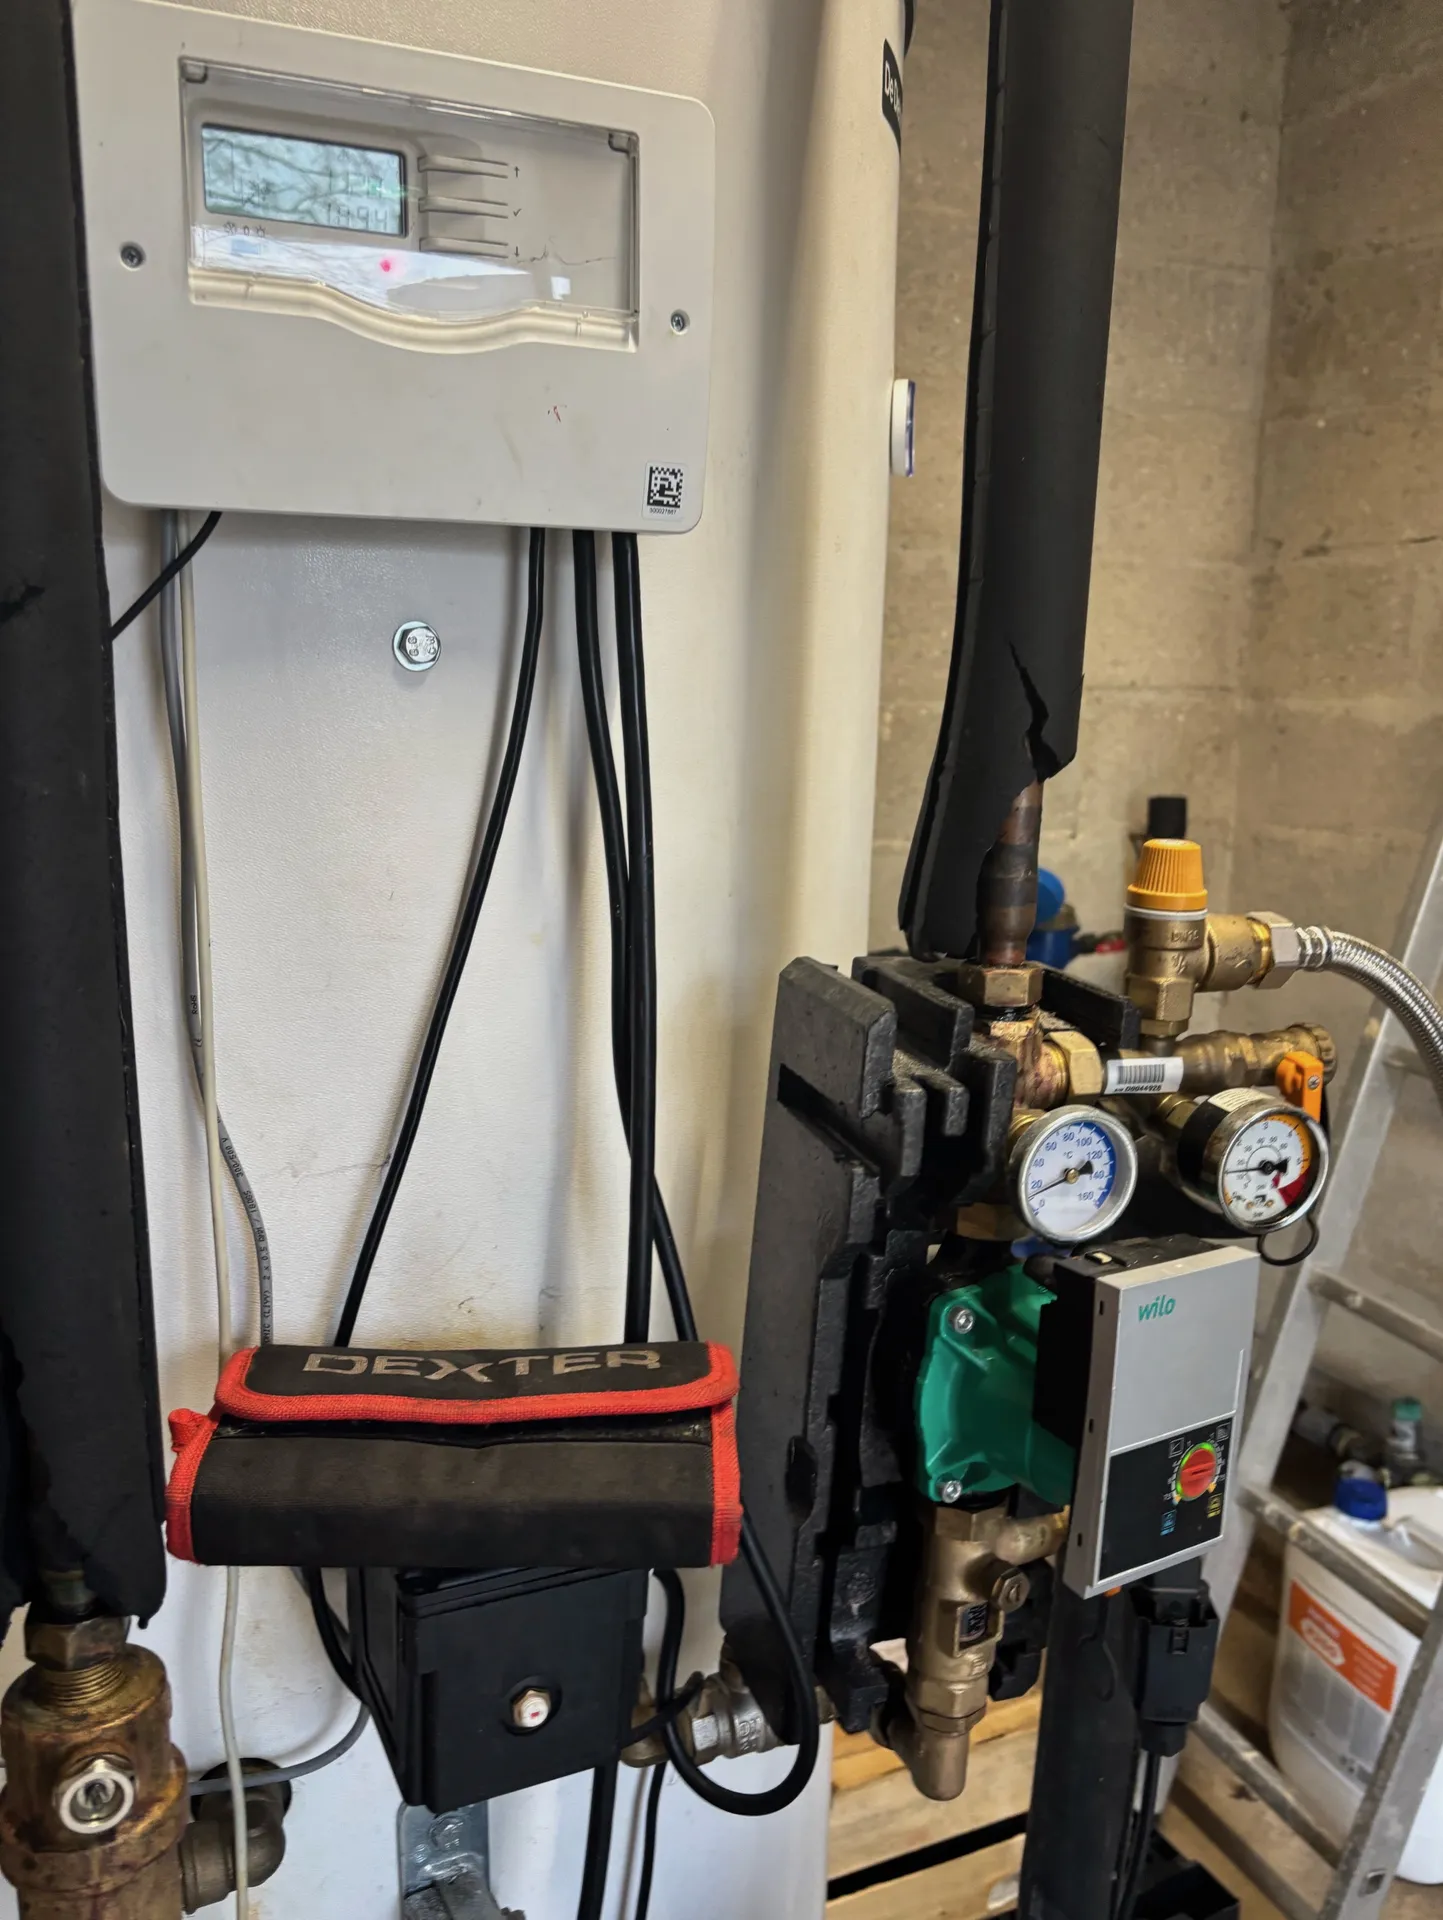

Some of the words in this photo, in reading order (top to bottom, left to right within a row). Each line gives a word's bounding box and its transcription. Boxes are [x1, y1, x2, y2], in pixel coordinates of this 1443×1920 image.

[884, 60, 893, 104] De
[189, 994, 198, 1016] RoHS
[1063, 1131, 1075, 1142] 80
[1075, 1136, 1093, 1147] 100
[1045, 1141, 1057, 1152] 60
[1086, 1149, 1103, 1161] 120
[1031, 1179, 1043, 1190] 20
[1138, 1294, 1177, 1322] wilo
[302, 1349, 662, 1383] DEXTER
